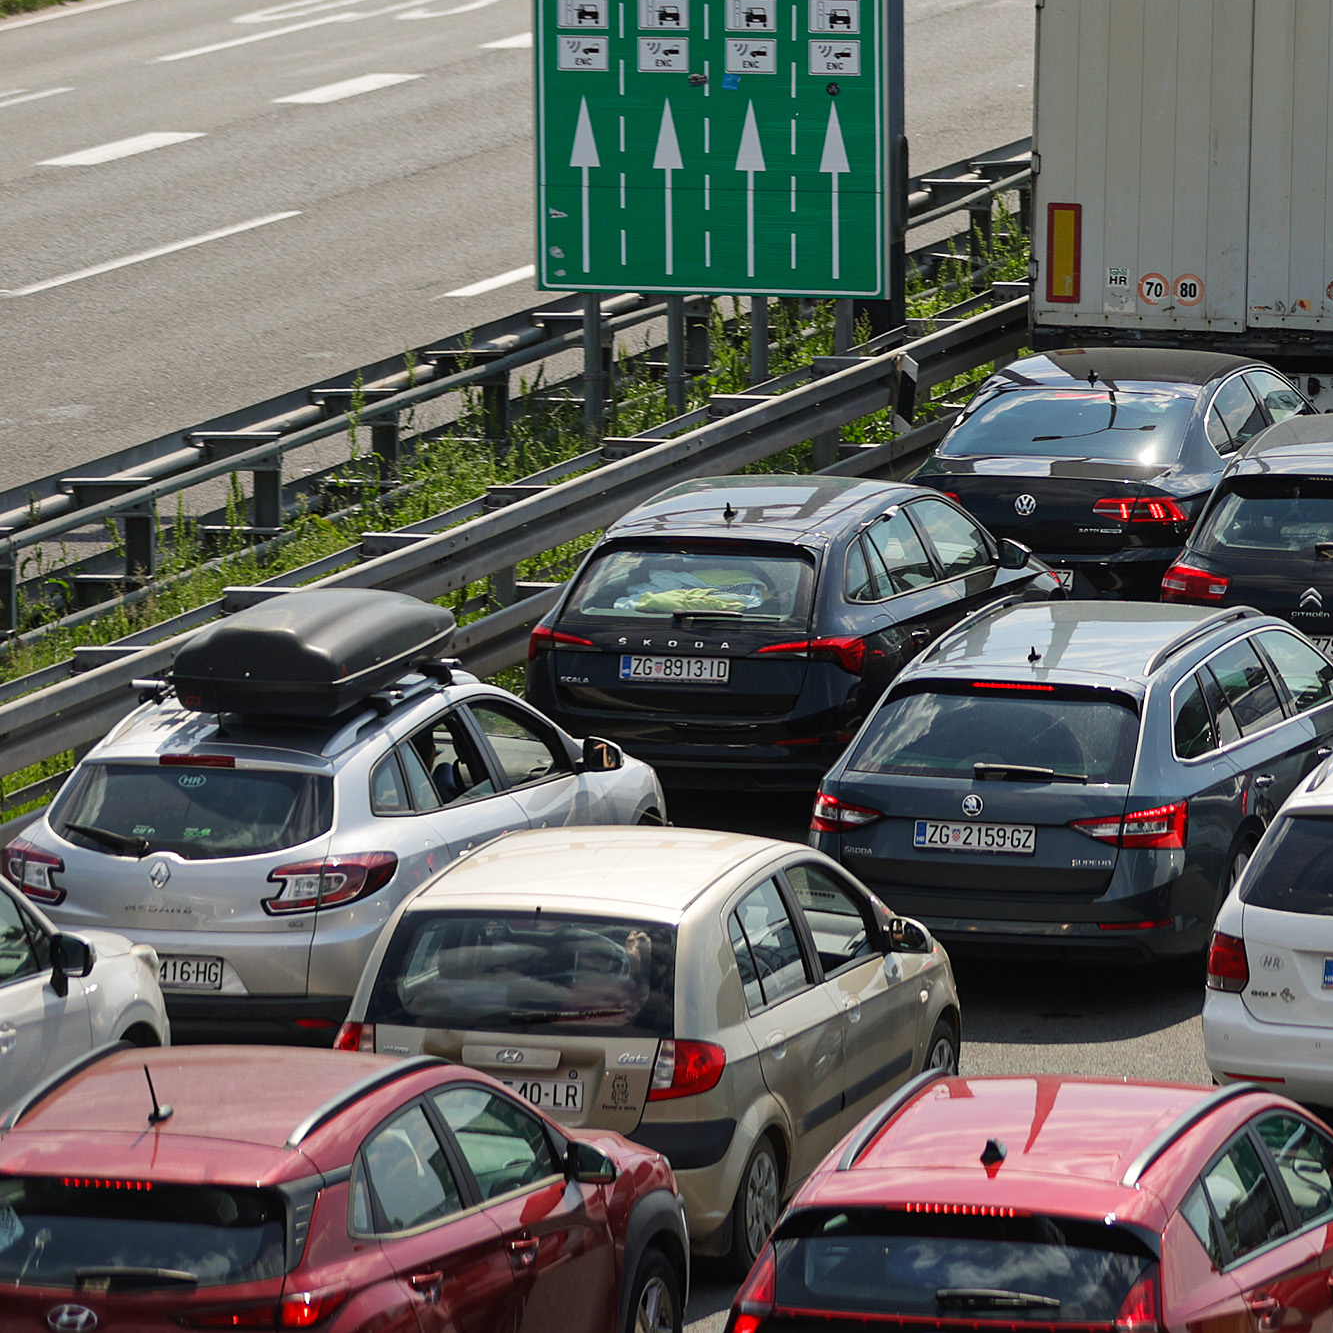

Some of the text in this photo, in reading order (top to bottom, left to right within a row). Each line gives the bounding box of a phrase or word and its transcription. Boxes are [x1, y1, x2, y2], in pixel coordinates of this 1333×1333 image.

[575, 57, 592, 66] ENC
[655, 58, 672, 67] ENC
[742, 60, 759, 69] ENC
[826, 61, 843, 70] ENC
[1109, 276, 1127, 285] HR
[1145, 281, 1163, 298] 70
[1180, 282, 1197, 298] 80
[617, 635, 731, 651] ŠKODA
[631, 657, 654, 676] ZG
[559, 675, 590, 684] SCALA
[183, 776, 201, 785] HR
[927, 824, 951, 845] ZG
[1263, 956, 1281, 970] HR
[617, 1052, 650, 1065] Getz
